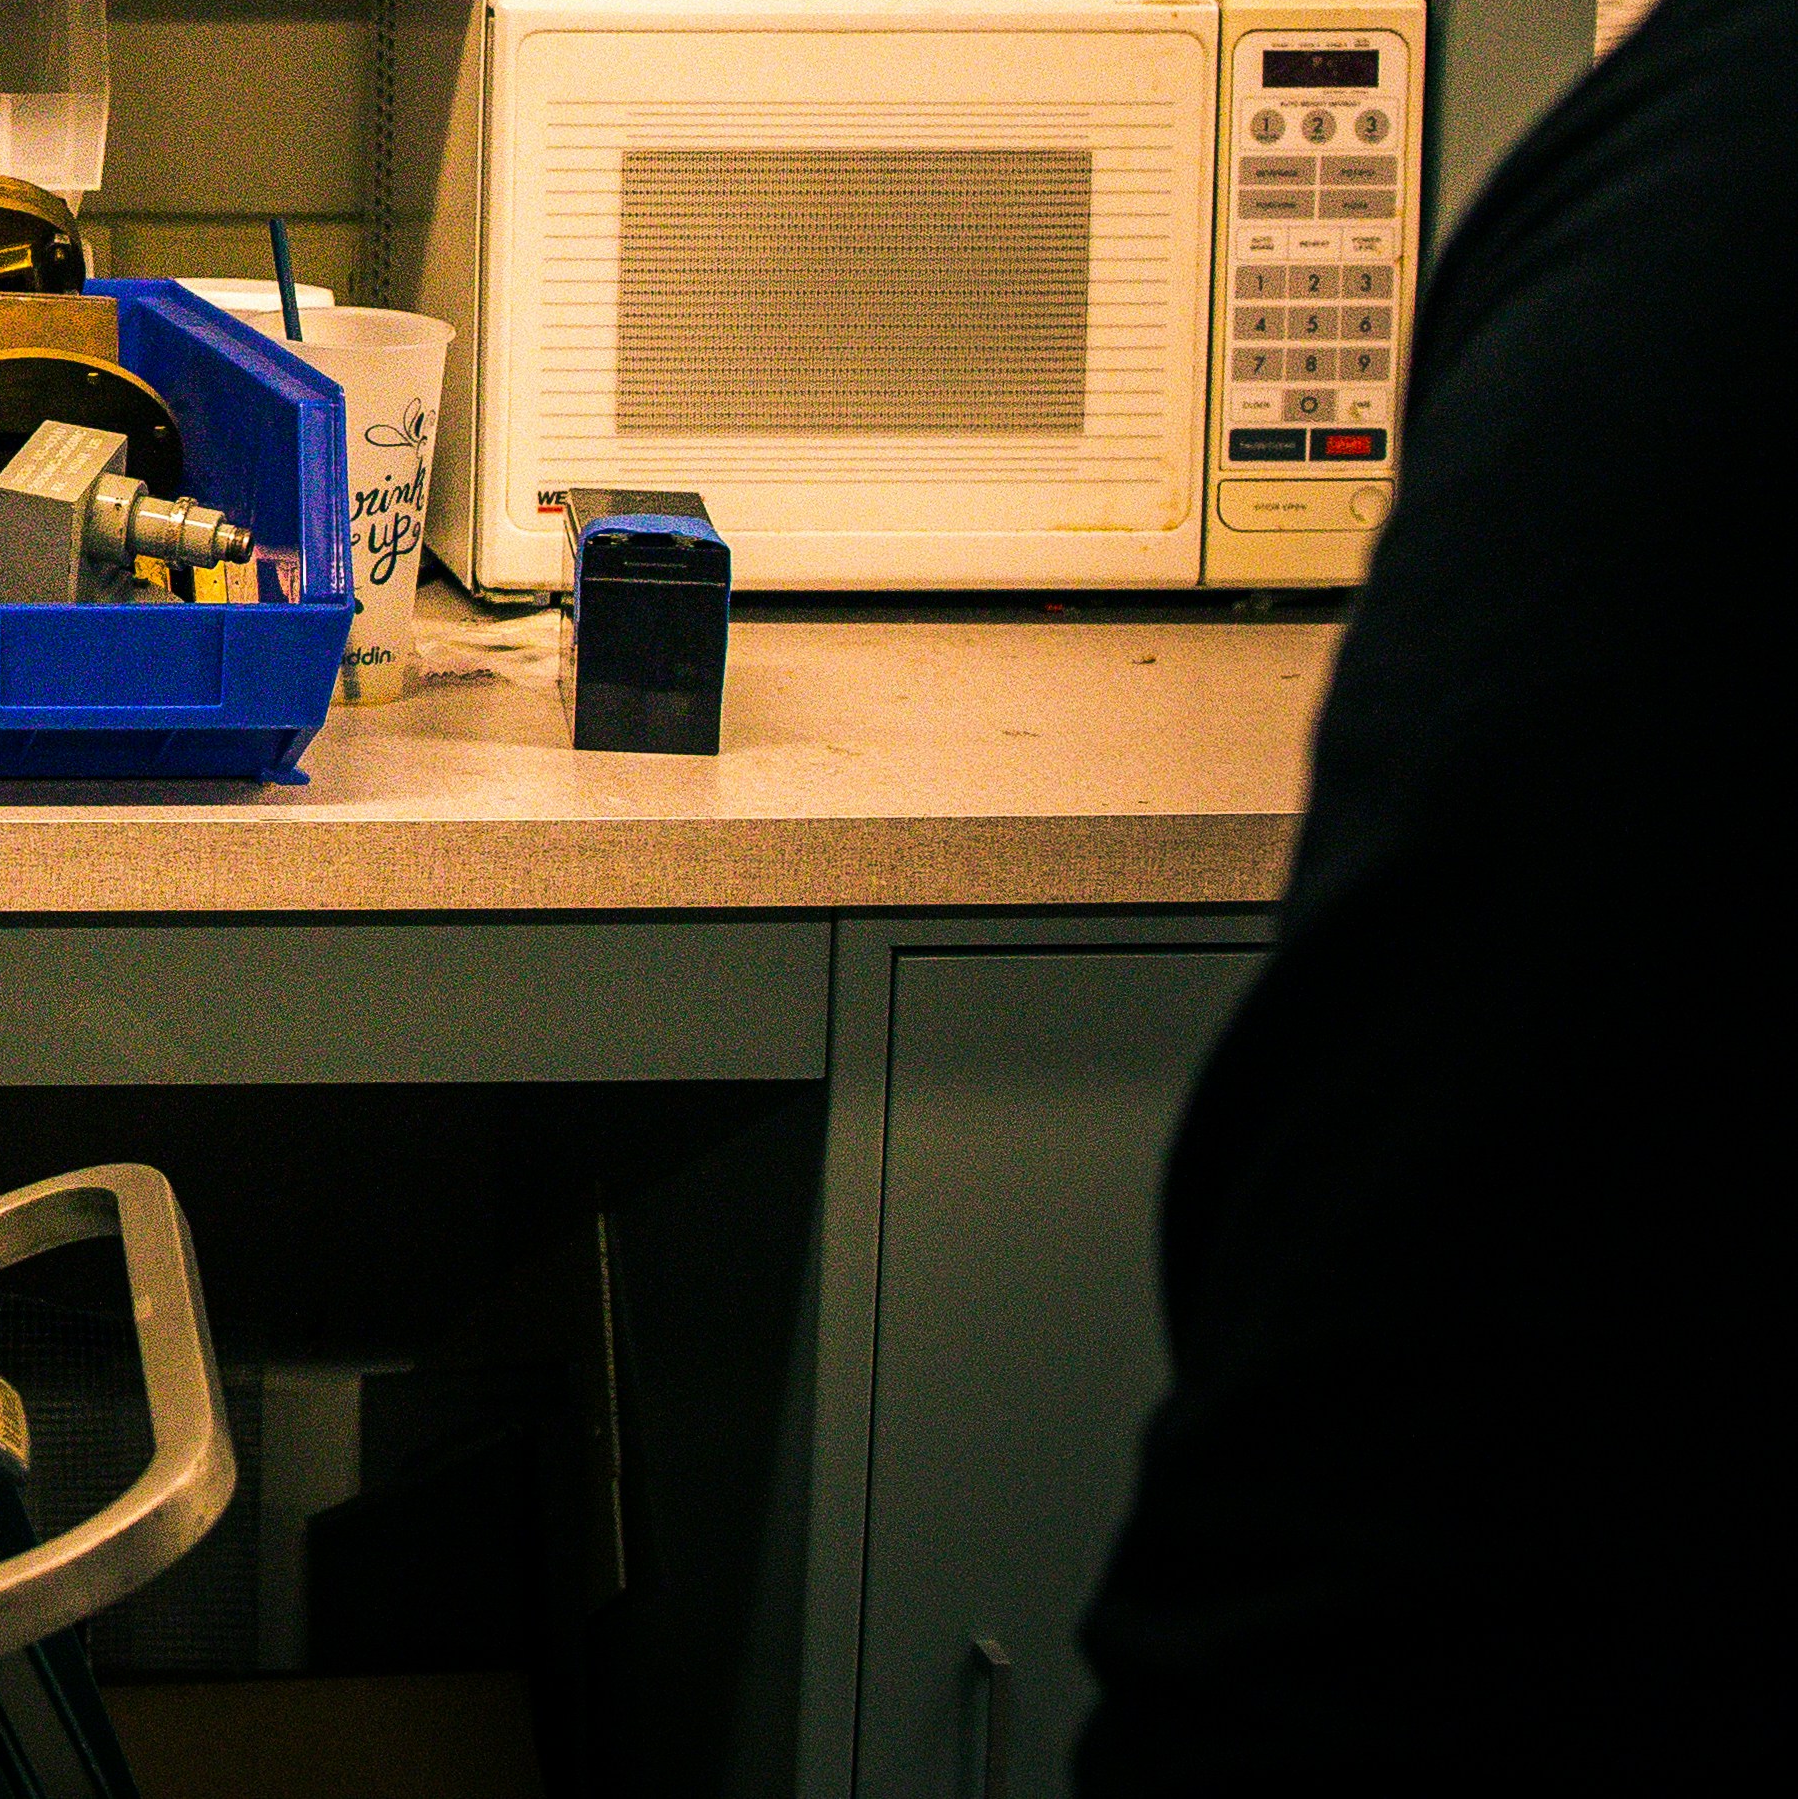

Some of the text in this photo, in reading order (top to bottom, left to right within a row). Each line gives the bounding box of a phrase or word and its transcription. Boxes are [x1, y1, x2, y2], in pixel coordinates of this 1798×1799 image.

[1262, 116, 1378, 133] 1 2 3
[1257, 274, 1372, 292] 1 2 3
[1255, 316, 1372, 333] 4 5 6
[1253, 355, 1370, 373] 7 8 9
[1299, 396, 1319, 415] 0
[351, 457, 425, 523] rink
[367, 512, 422, 585] up
